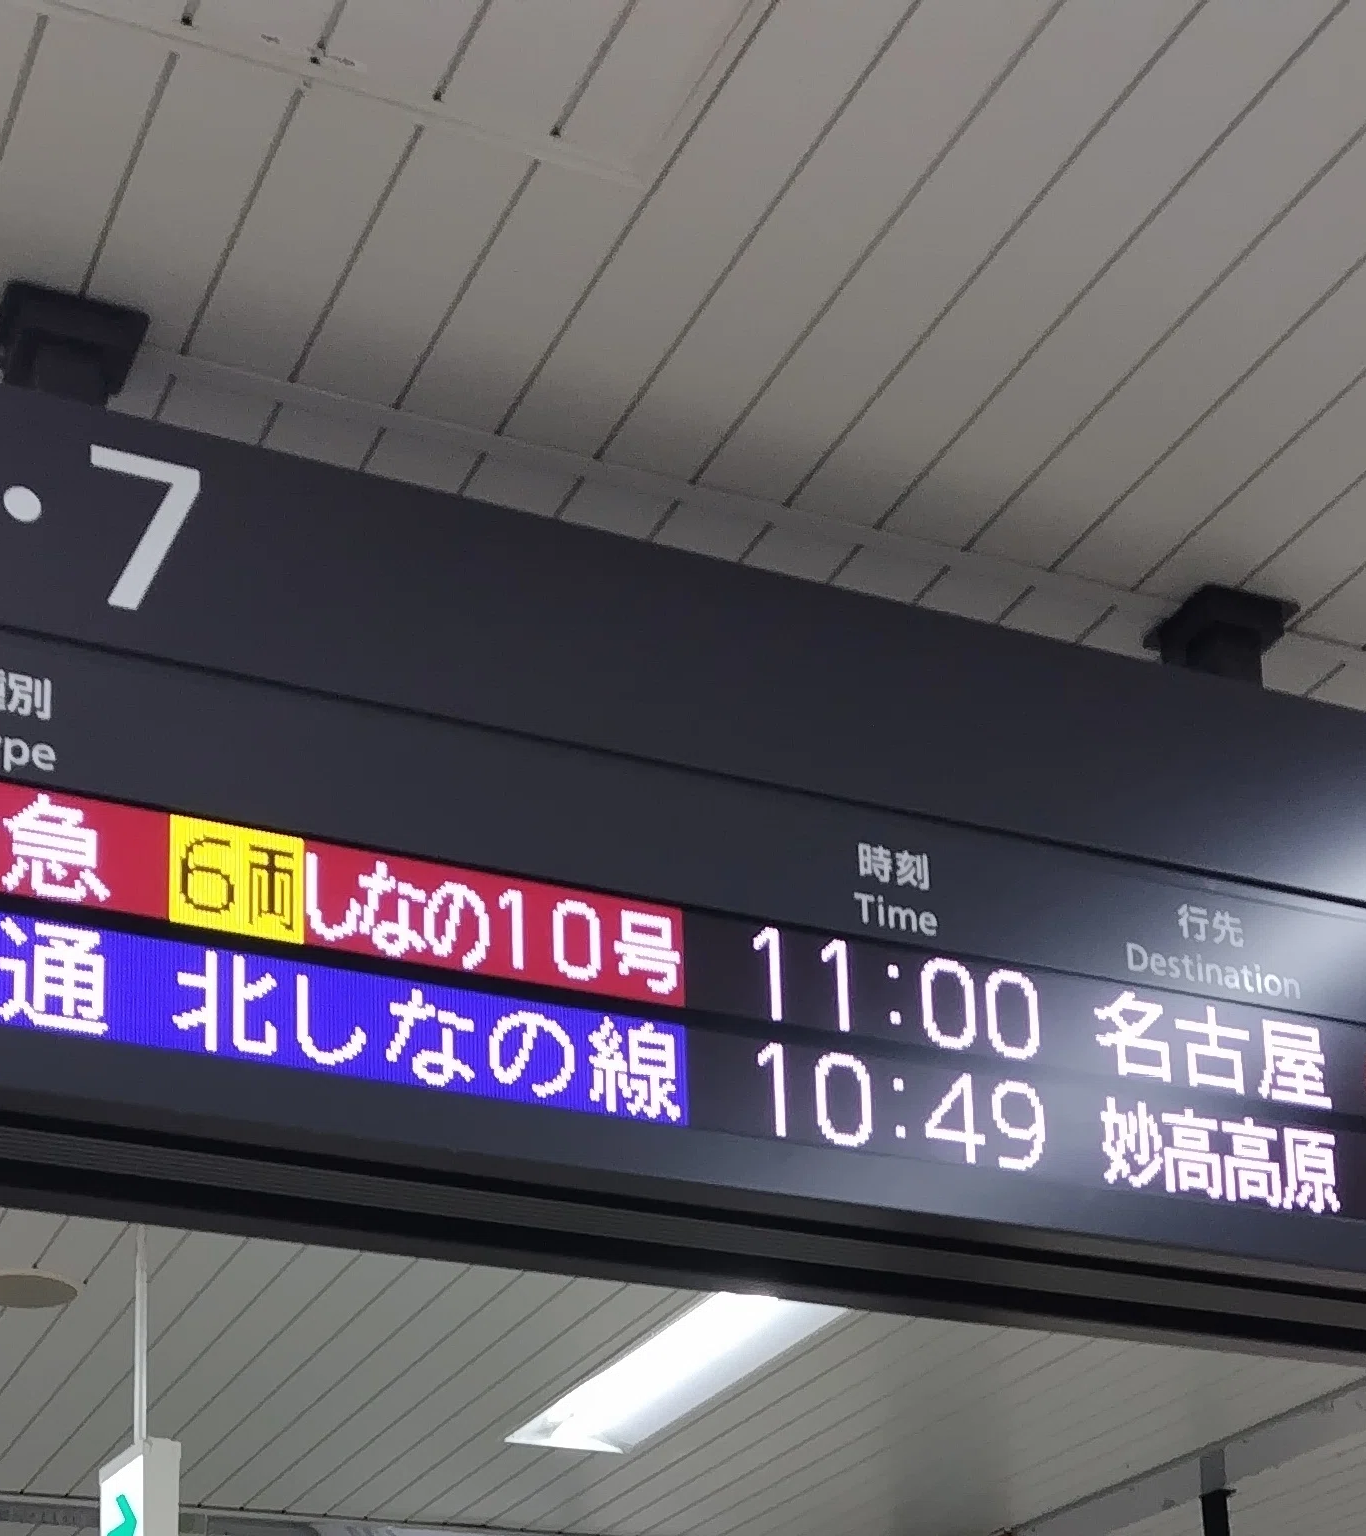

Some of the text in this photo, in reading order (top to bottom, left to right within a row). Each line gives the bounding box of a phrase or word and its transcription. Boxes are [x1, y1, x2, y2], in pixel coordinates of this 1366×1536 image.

[854, 892, 938, 937] Time
[857, 842, 929, 891] 時刻
[1126, 941, 1300, 1000] Destination
[1178, 903, 1244, 950] 行先
[172, 953, 682, 1121] 北しなの線
[751, 926, 1040, 1060] 11:00
[1093, 989, 1332, 1110] 名古屋
[756, 1040, 1045, 1173] 10:49
[1100, 1097, 1341, 1216] 妙高高原
